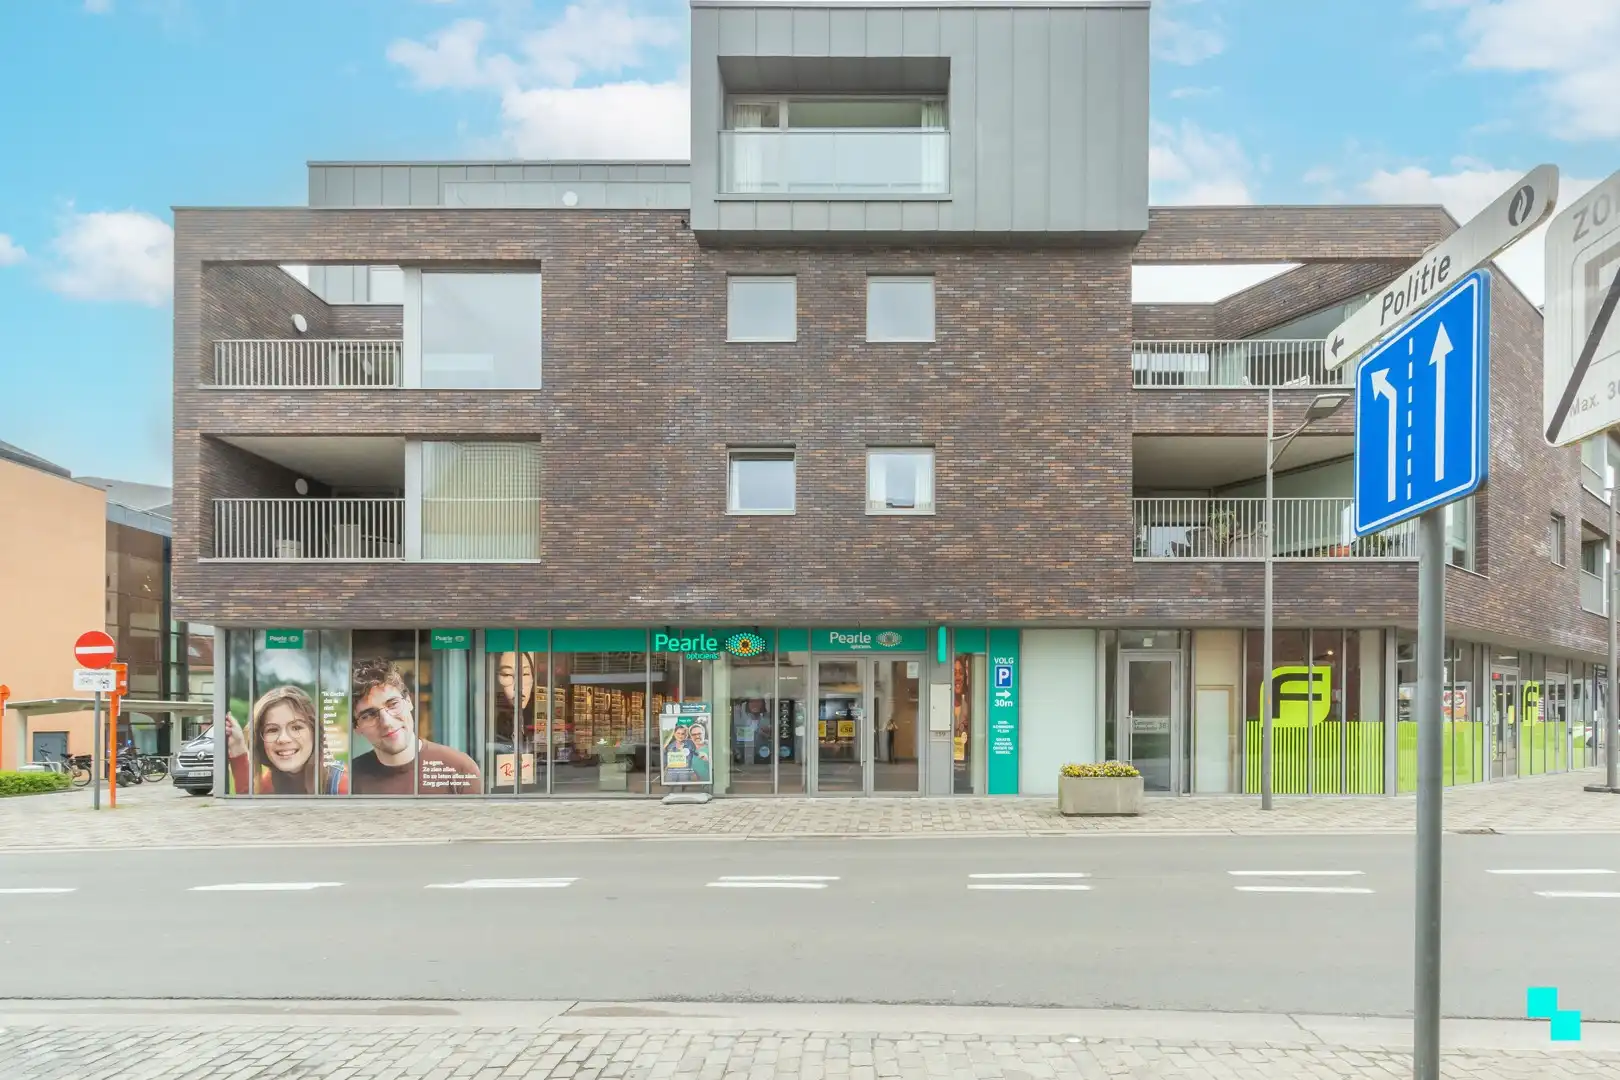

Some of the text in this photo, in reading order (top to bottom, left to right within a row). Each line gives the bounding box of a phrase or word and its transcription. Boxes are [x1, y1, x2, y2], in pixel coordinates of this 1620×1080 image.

[1572, 190, 1620, 244] ZO
[1380, 255, 1451, 326] Politie
[1607, 378, 1620, 401] 3
[655, 633, 718, 652] Pearle
[829, 631, 872, 644] Pearle
[686, 652, 718, 661] opticiens
[994, 656, 1014, 664] VOLG
[998, 668, 1010, 685] P
[994, 699, 1013, 707] 30m
